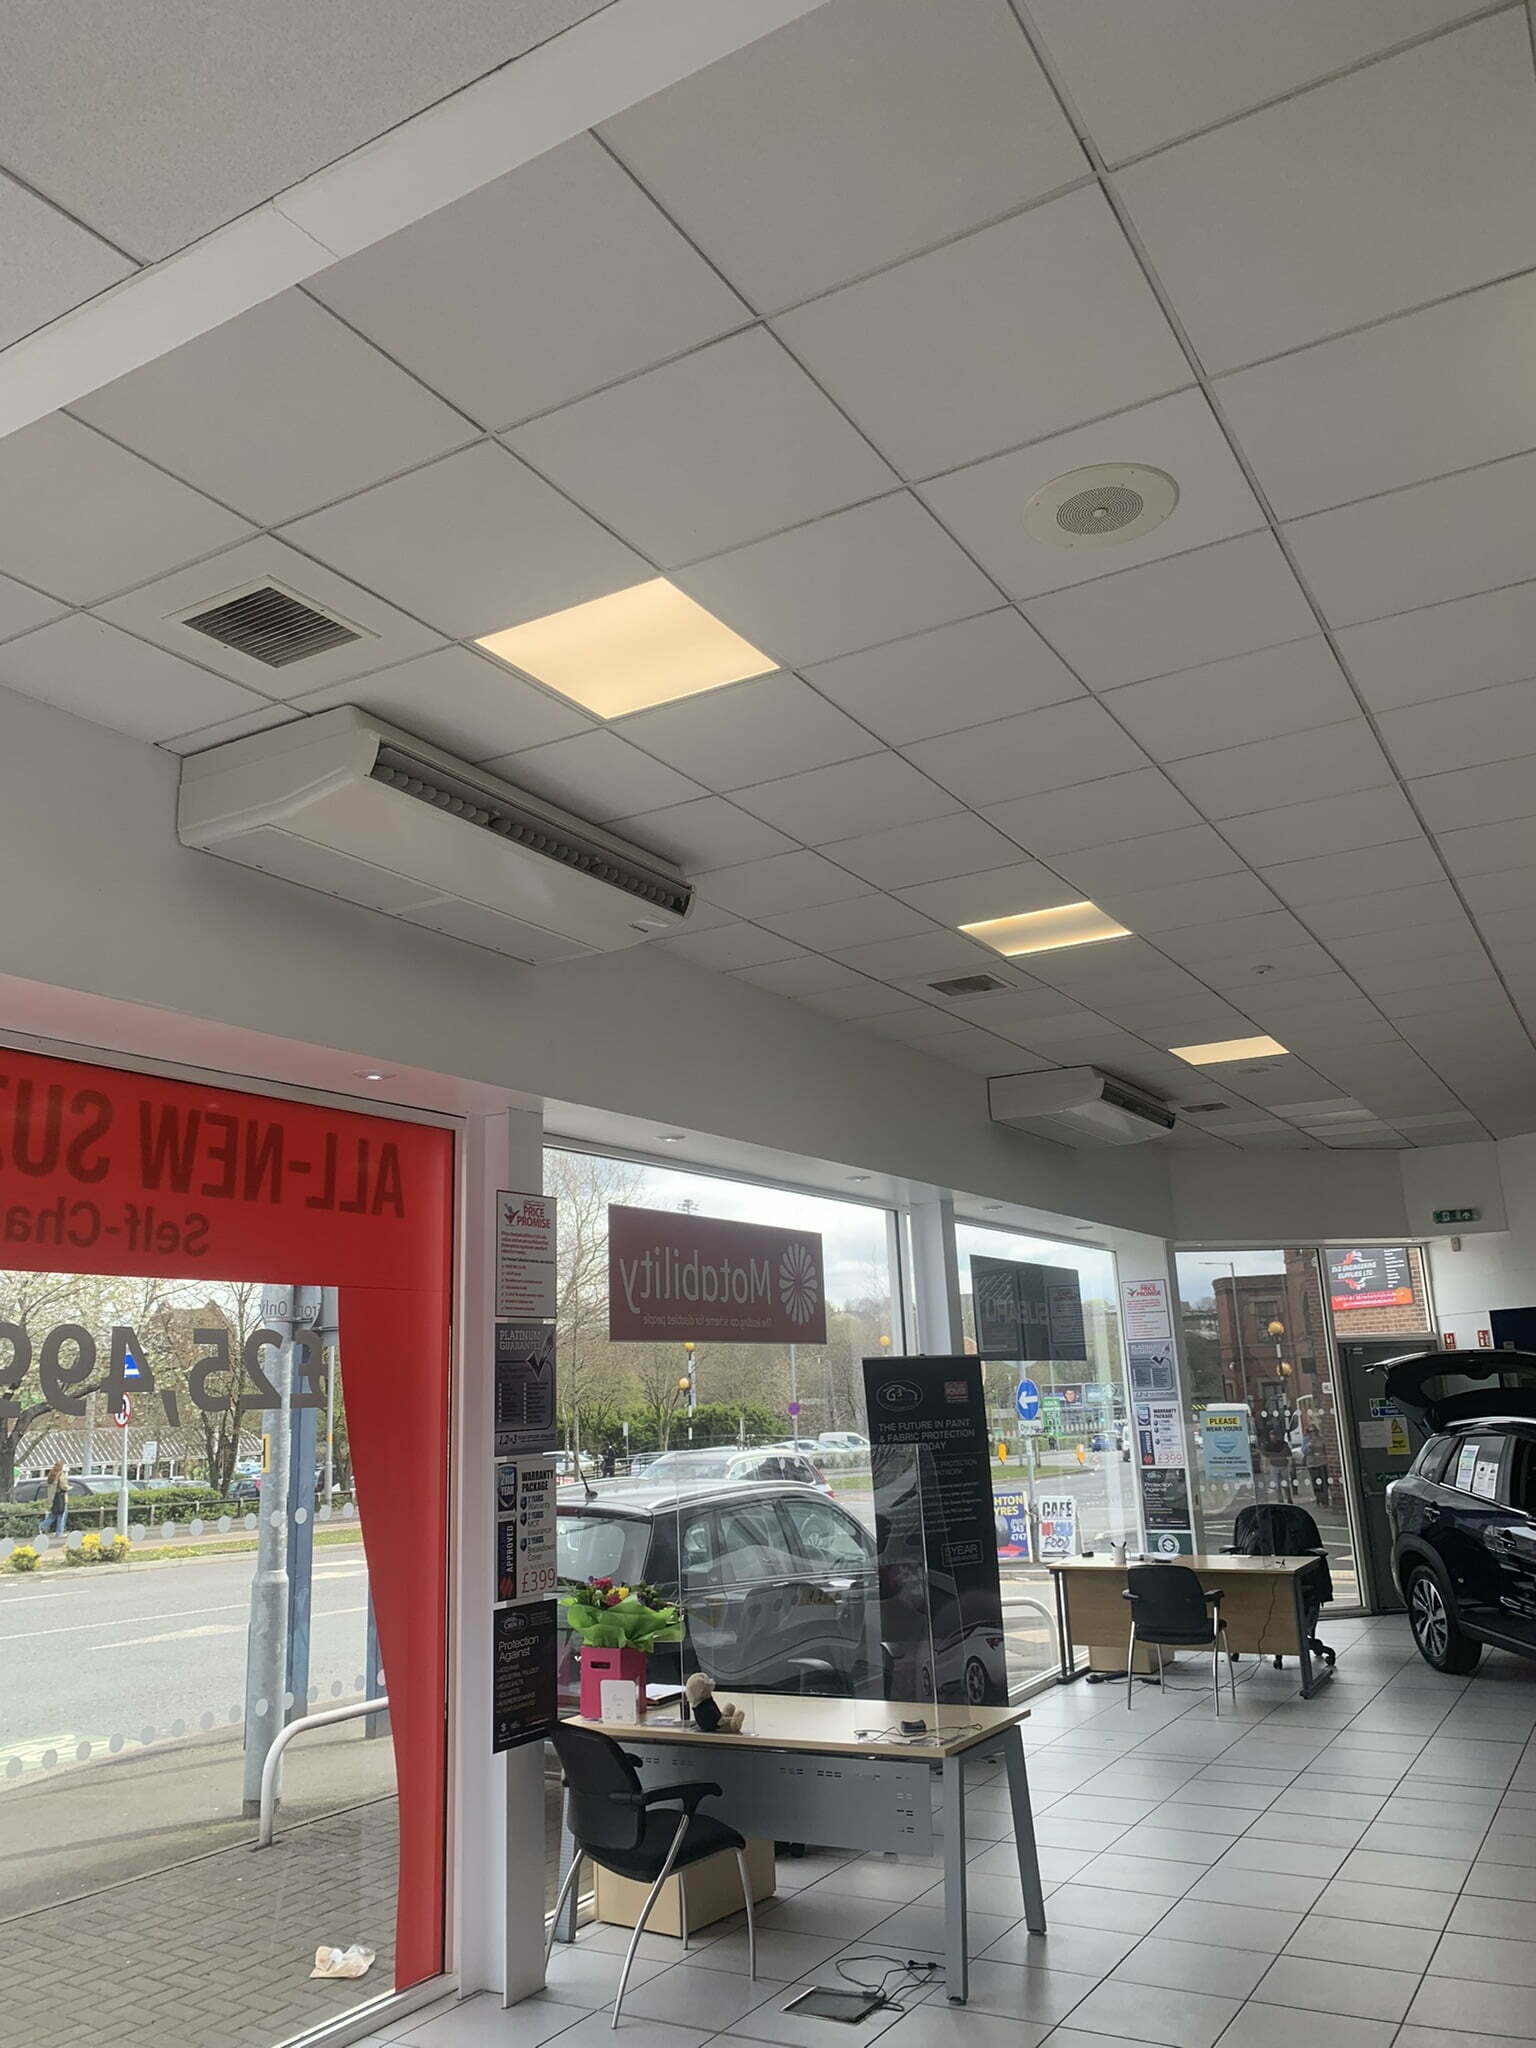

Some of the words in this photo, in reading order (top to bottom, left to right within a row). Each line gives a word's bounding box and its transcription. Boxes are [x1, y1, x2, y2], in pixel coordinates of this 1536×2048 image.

[524, 1206, 545, 1217] PRICE
[517, 1216, 551, 1229] PROMISE
[879, 1422, 897, 1432] THE
[900, 1420, 933, 1431] FUTURE
[935, 1419, 944, 1429] IN
[946, 1418, 970, 1429] PAINT
[1209, 1417, 1238, 1425] PLEASE
[880, 1434, 886, 1443] &
[888, 1431, 920, 1442] FABRIC
[921, 1428, 976, 1440] PROTECTION
[521, 1469, 554, 1481] WARRANTY
[521, 1480, 549, 1493] PACKAGE
[994, 1505, 1019, 1516] YRES
[1042, 1498, 1073, 1517] CAFÉ
[506, 1524, 514, 1573] APPROVED
[521, 1567, 556, 1593] £399
[498, 1634, 540, 1653] Protection
[499, 1647, 530, 1663] Against
